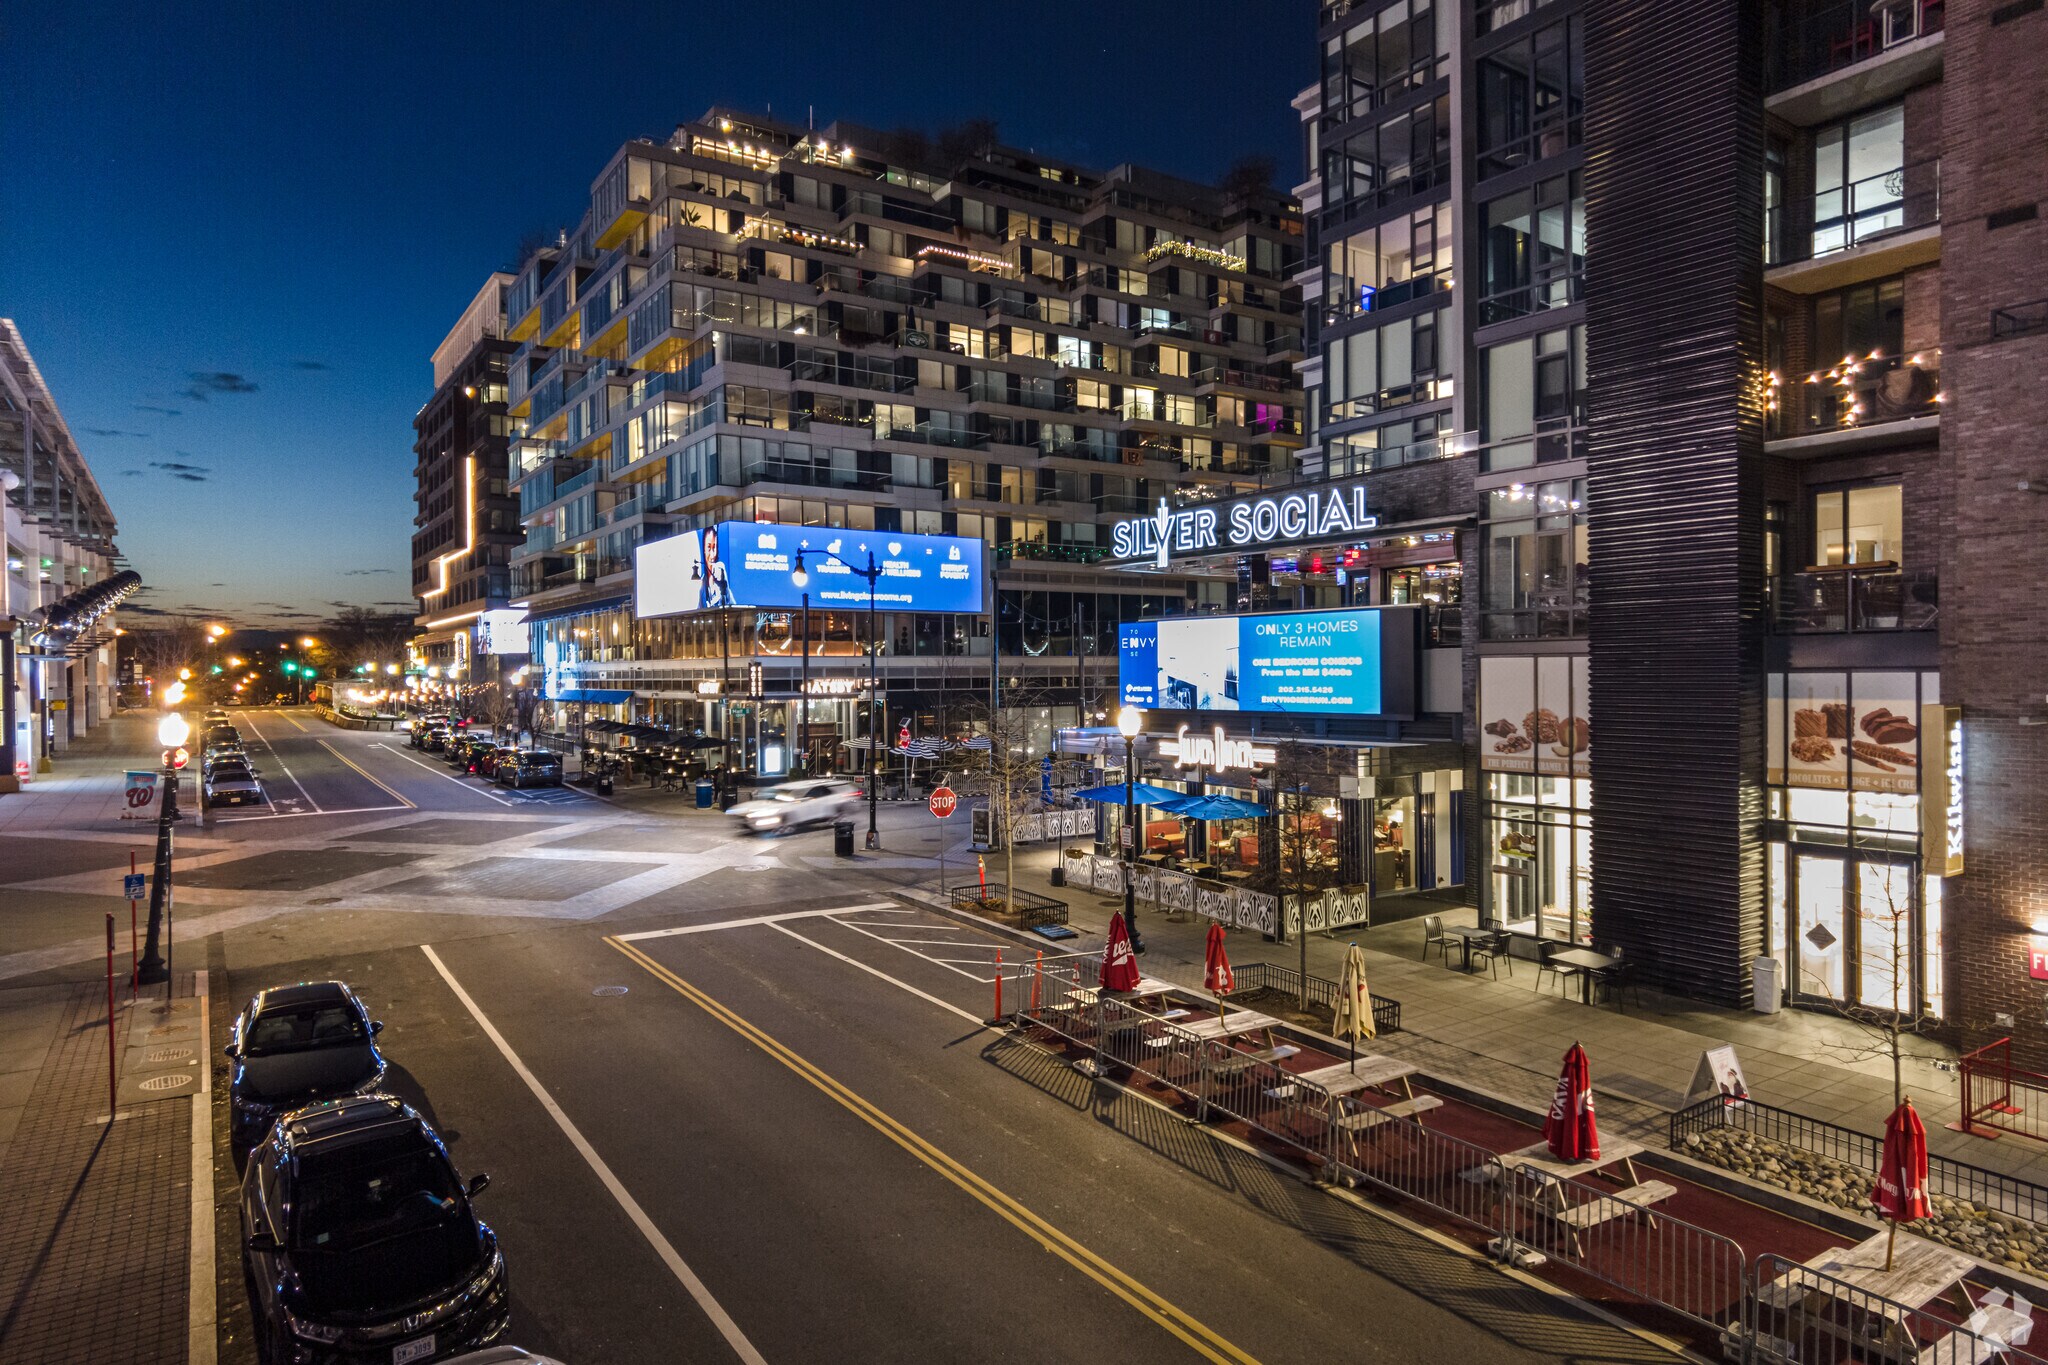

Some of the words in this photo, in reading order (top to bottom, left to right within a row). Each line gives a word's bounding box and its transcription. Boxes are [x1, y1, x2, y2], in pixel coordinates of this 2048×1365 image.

[1112, 497, 1218, 568] SILVER
[1229, 486, 1377, 545] SOCIAL
[1256, 623, 1291, 636] ONLY
[1295, 622, 1303, 634] 3
[1307, 620, 1359, 634] HOMES
[1121, 637, 1156, 649] ENVY
[1279, 635, 1332, 648] REMAIN
[1252, 658, 1271, 667] ONE
[1272, 657, 1319, 667] BEDROOM
[1320, 656, 1363, 666] CONDOS
[1285, 668, 1301, 677] the
[1487, 758, 1501, 768] THE
[1501, 759, 1530, 770] PERFECT
[1530, 761, 1563, 772] CRAMEL
[1779, 772, 1832, 785] COCOLATES
[1840, 775, 1871, 787] FDGE
[125, 785, 155, 809] W
[931, 796, 955, 809] STOP
